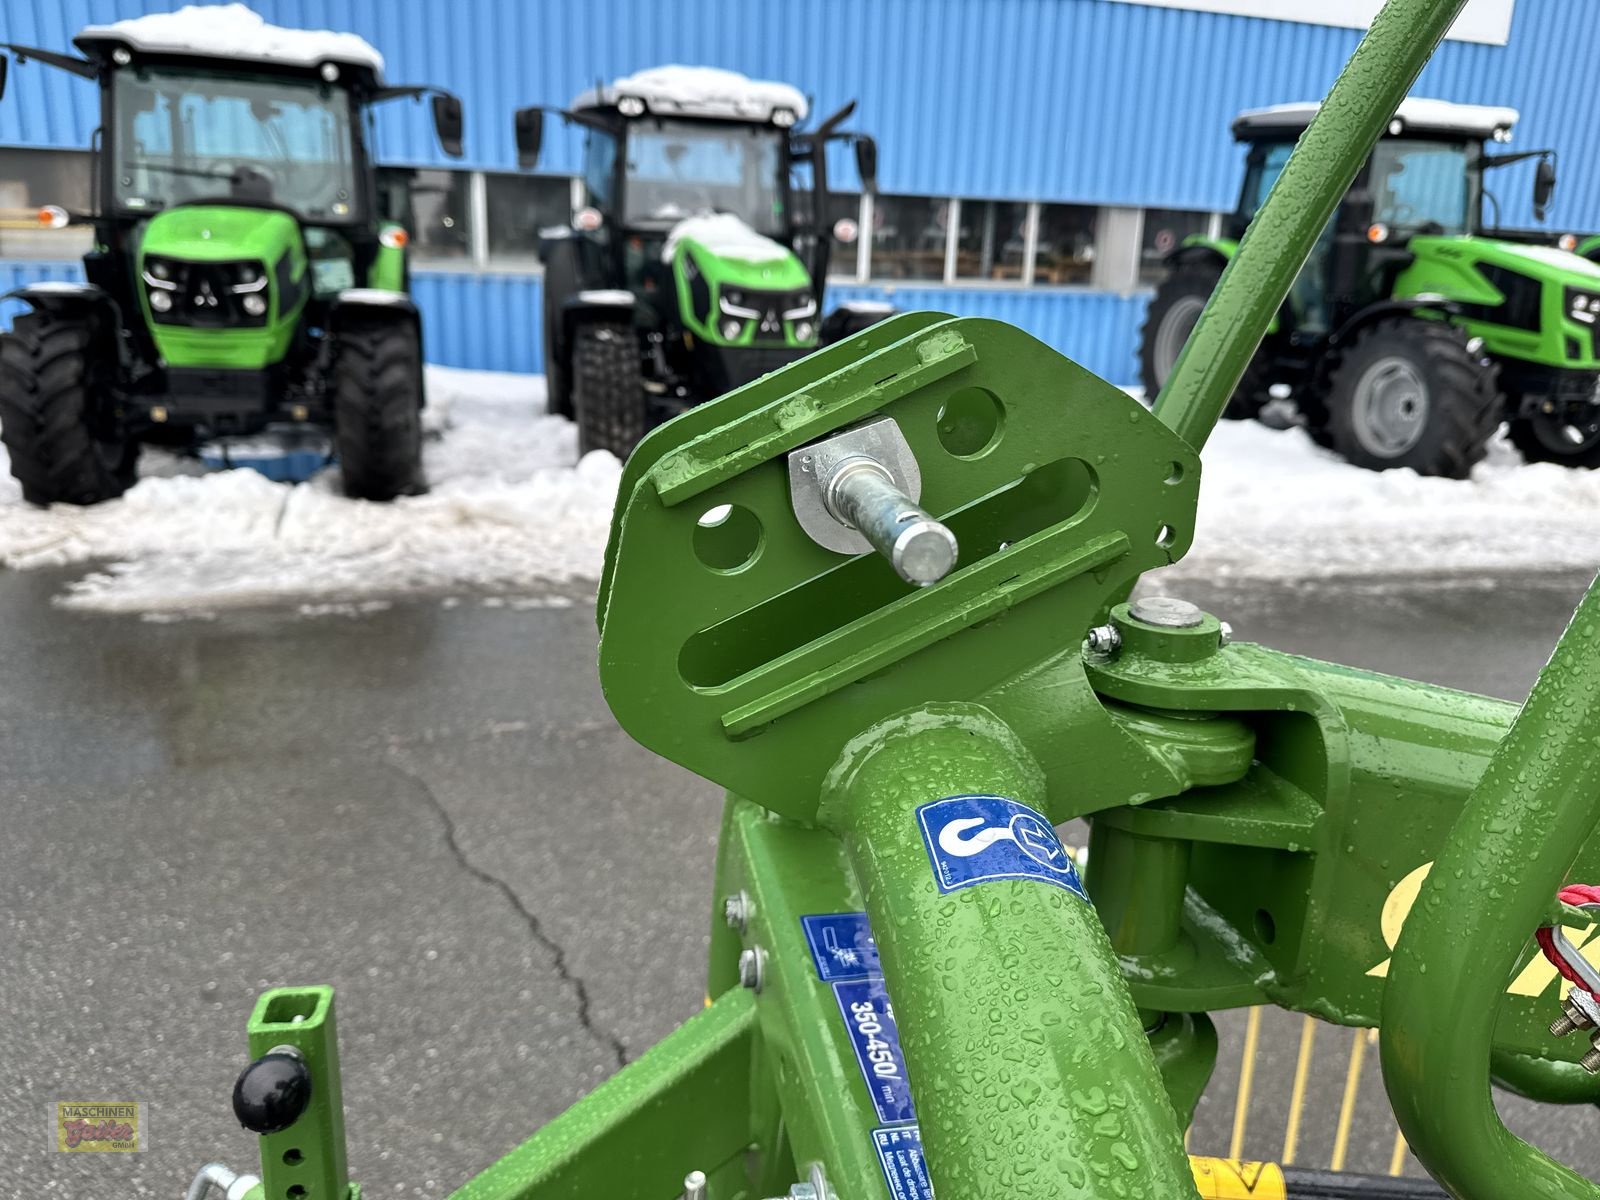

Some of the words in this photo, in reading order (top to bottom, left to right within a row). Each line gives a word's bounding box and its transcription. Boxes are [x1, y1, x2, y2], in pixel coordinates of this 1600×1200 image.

[881, 1085, 895, 1103] min
[878, 1133, 889, 1145] RU
[890, 1132, 900, 1144] NL
[901, 1131, 912, 1139] IT
[896, 1150, 909, 1167] Laat
[902, 1167, 912, 1178] de
